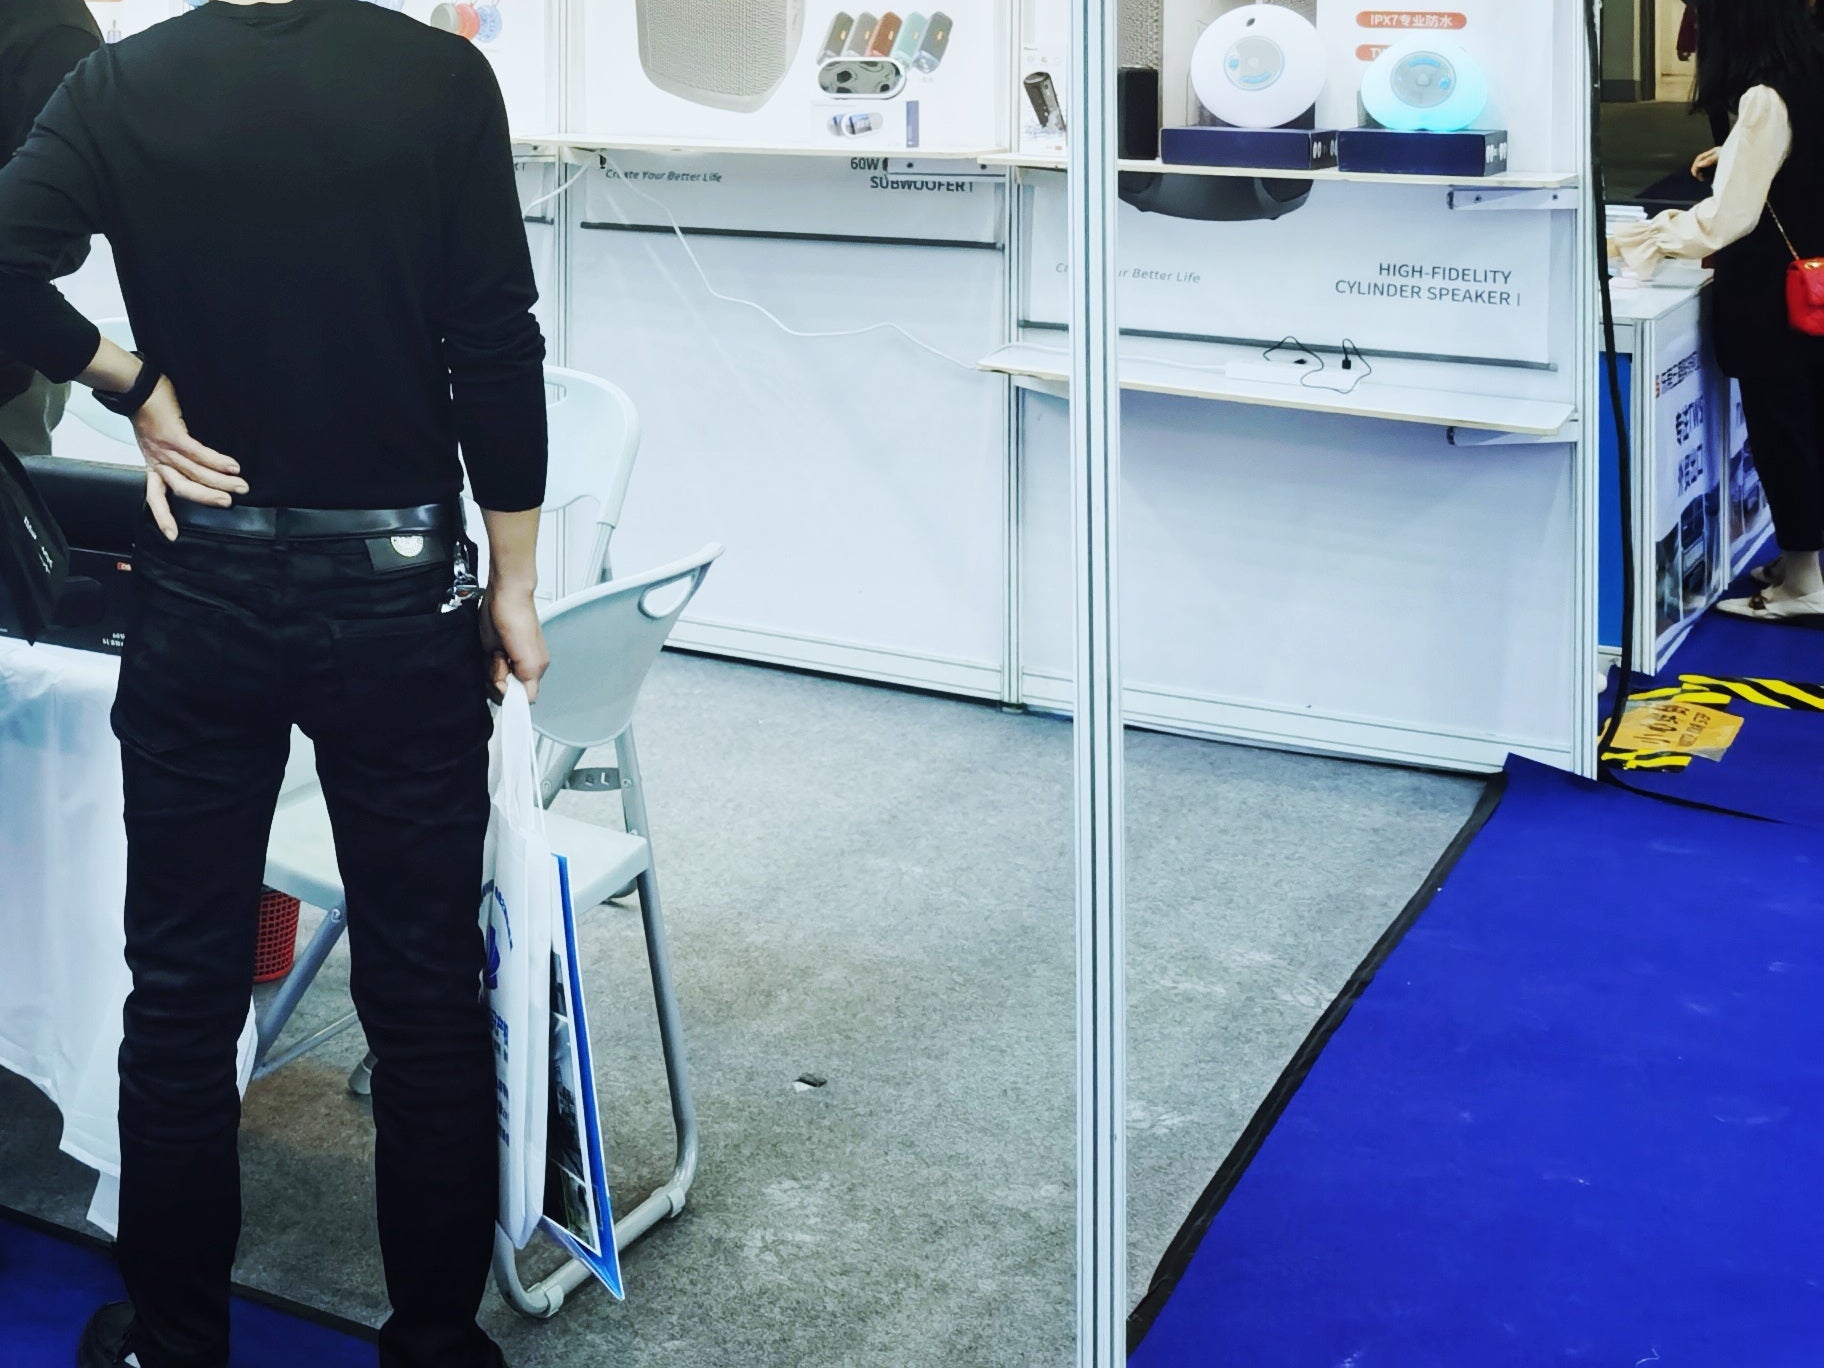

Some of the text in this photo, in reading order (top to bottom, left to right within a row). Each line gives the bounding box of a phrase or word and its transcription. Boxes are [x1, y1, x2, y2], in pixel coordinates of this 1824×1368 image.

[1369, 11, 1453, 29] IPX7专业防水
[849, 156, 878, 171] 60W
[642, 170, 666, 182] Your
[667, 170, 701, 183] Better
[702, 172, 722, 183] Life
[1132, 267, 1202, 285] Better Life
[1378, 261, 1513, 285] HIGH-FIDELITY
[1335, 279, 1512, 307] CYLINDER SPEAKER
